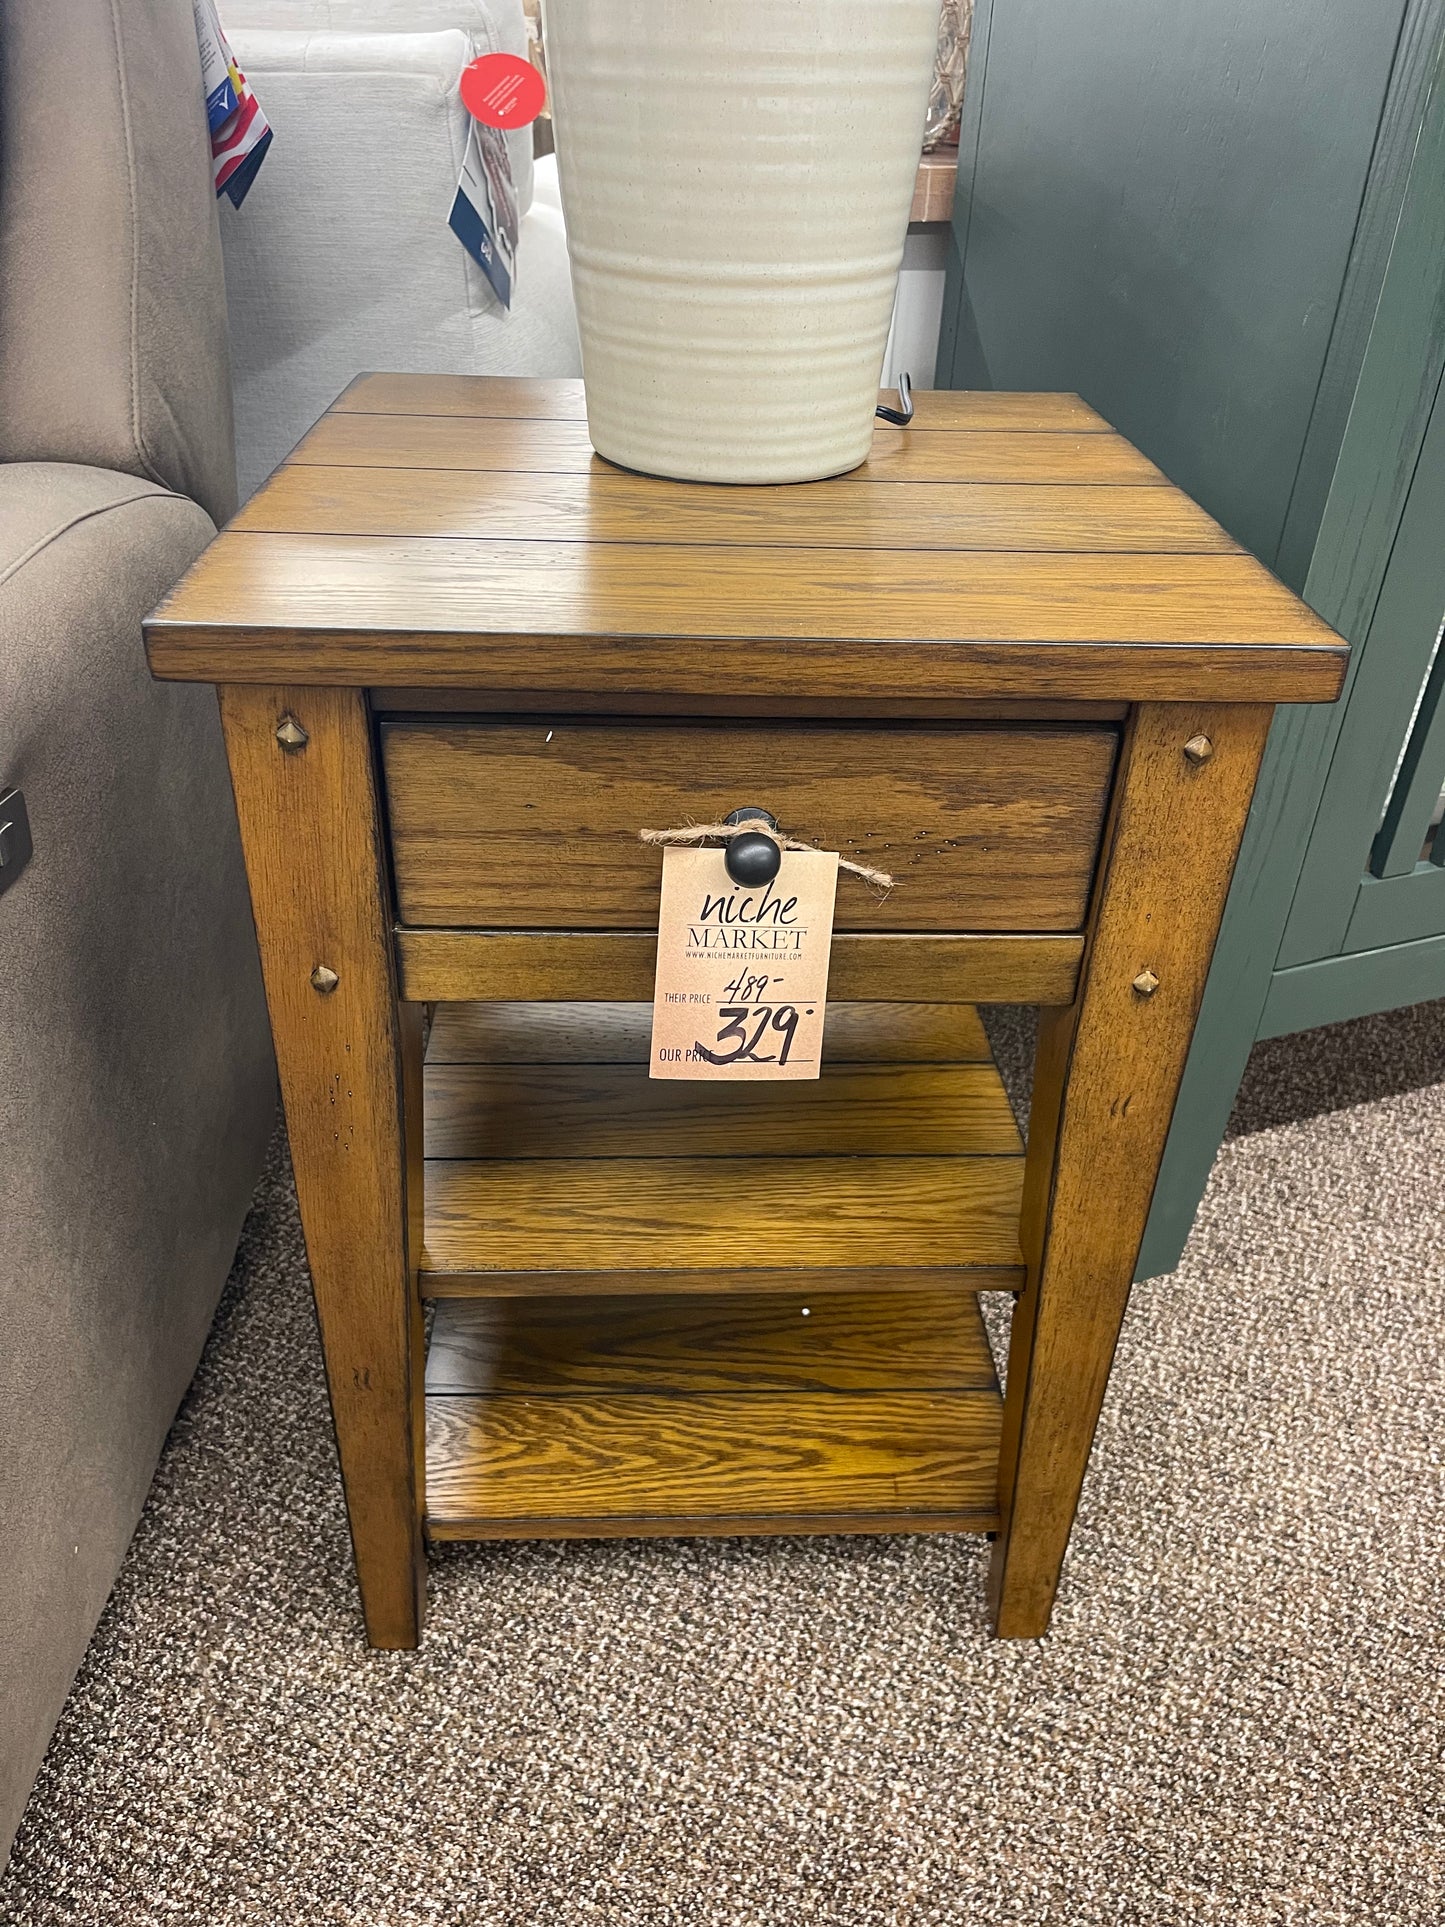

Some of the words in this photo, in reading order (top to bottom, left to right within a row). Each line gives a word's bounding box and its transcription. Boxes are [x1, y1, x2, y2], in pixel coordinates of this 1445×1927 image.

[700, 879, 798, 924] niche
[685, 928, 807, 949] MARKET
[685, 951, 802, 960] WWW.NICHEMARKETFURNITURE.COM
[664, 993, 687, 1003] THEIR
[689, 994, 711, 1004] PRICE
[659, 1048, 681, 1061] OUR
